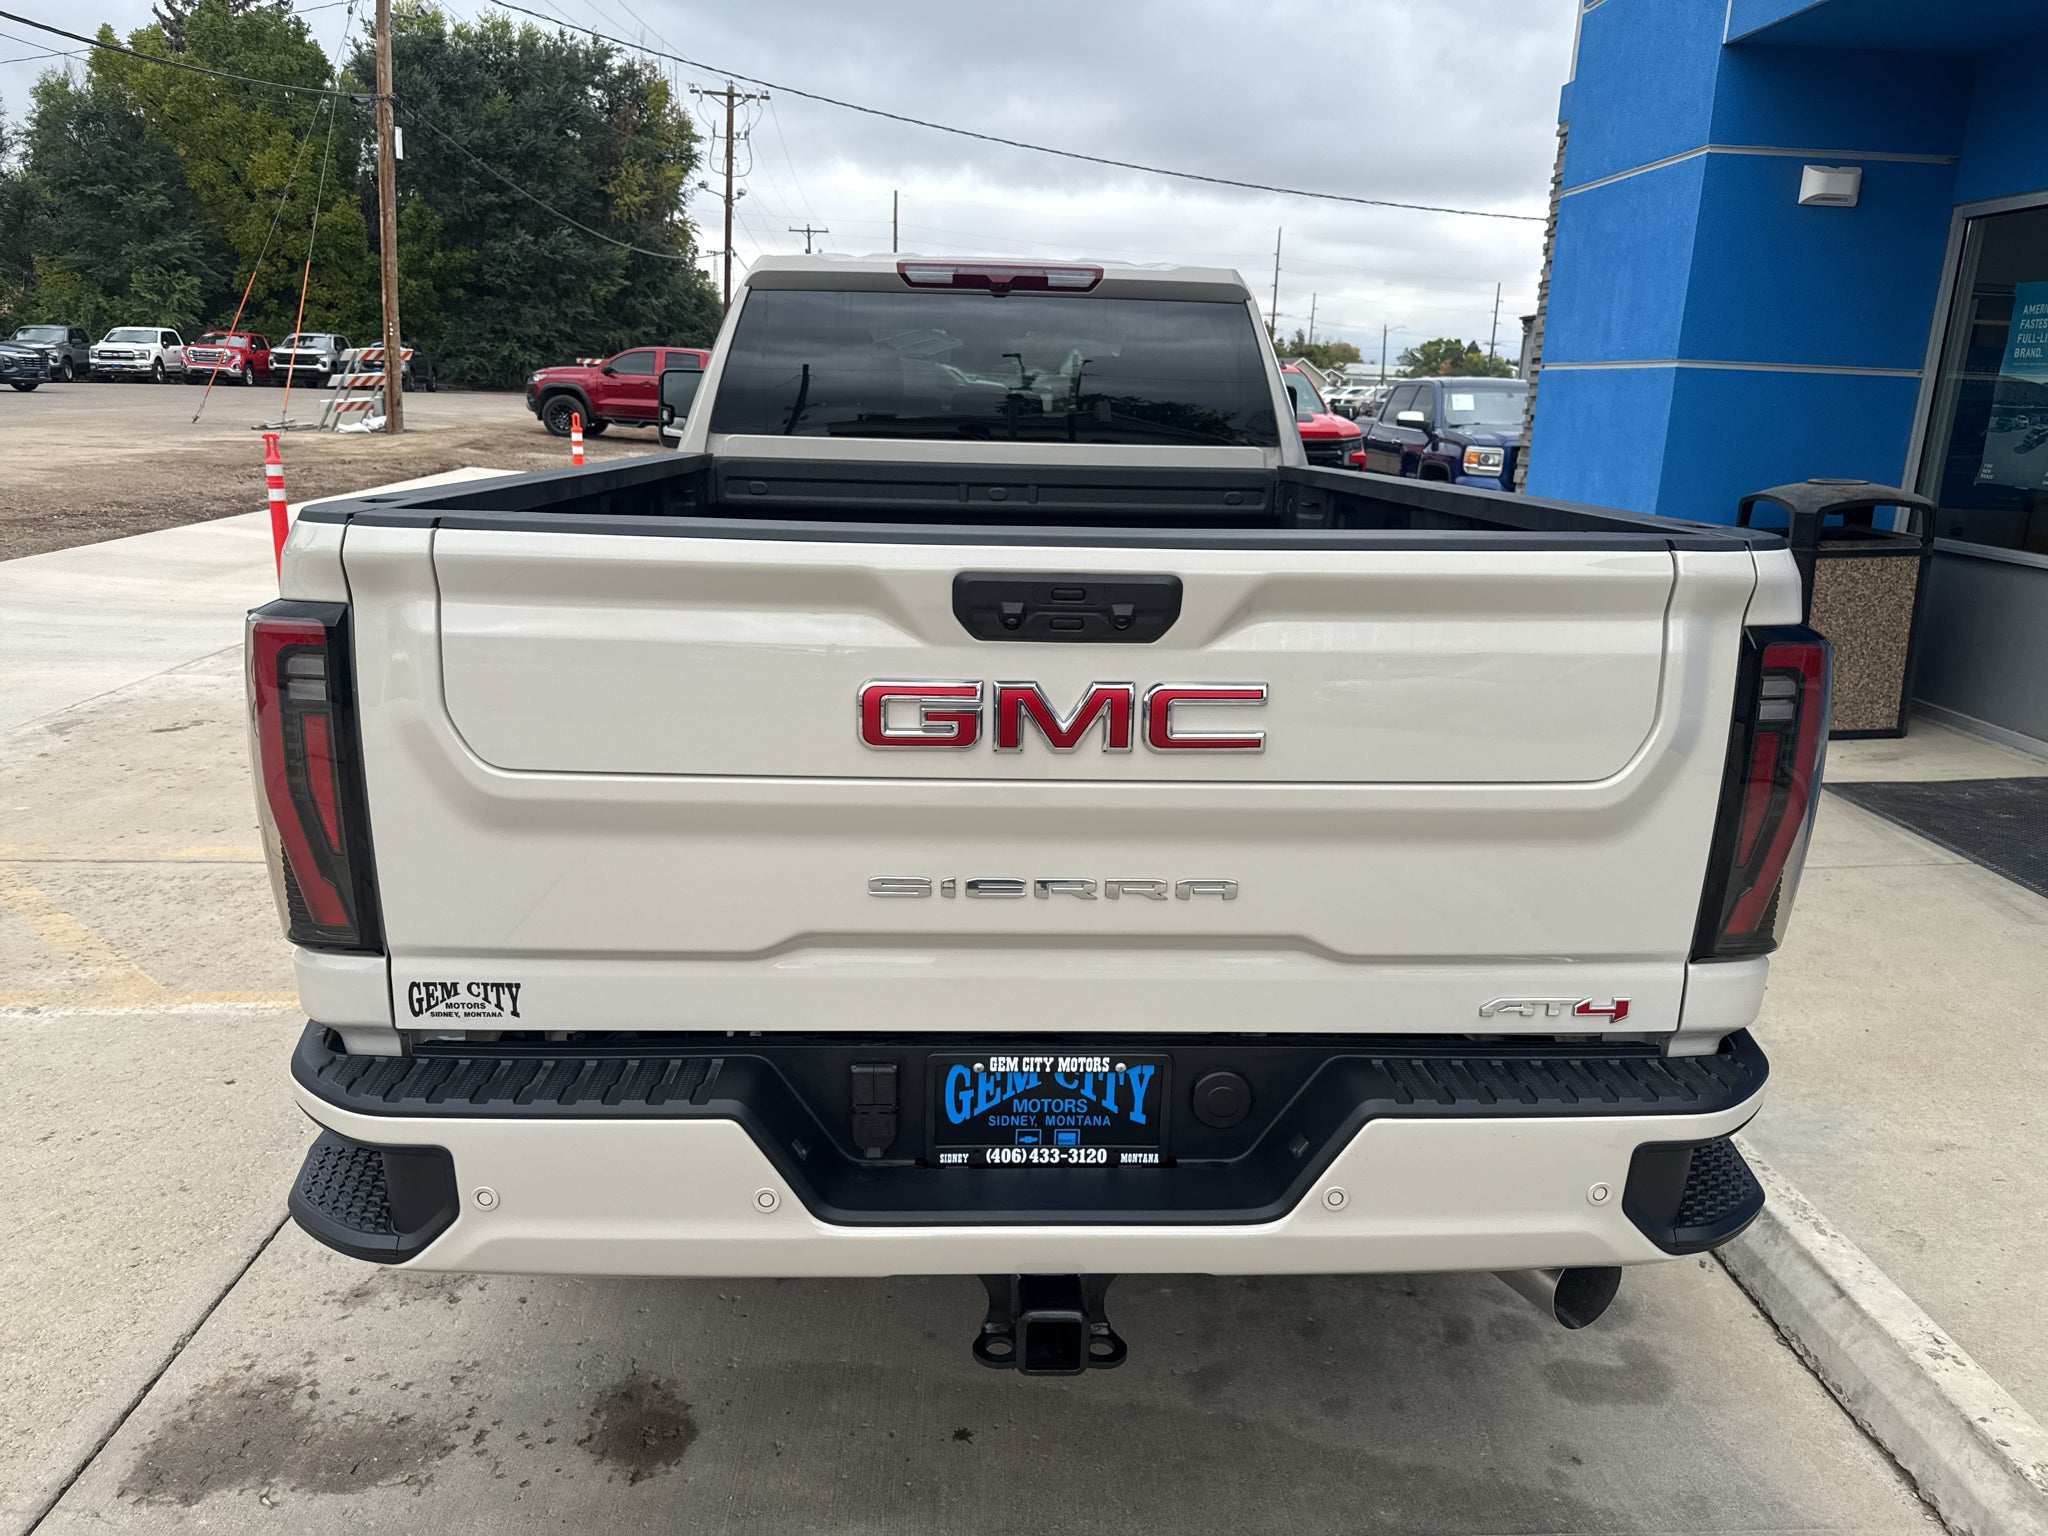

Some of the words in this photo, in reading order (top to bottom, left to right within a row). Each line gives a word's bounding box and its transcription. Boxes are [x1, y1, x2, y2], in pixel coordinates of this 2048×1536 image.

[2013, 347, 2043, 358] BRAND.
[857, 678, 1269, 755] GMC
[867, 875, 1239, 901] SIERRA
[408, 981, 460, 1018] GEM
[466, 982, 521, 1018] CITY
[445, 1002, 487, 1010] MOTORS
[1479, 997, 1632, 1023] AT4
[989, 1056, 1020, 1072] GEM
[1022, 1056, 1055, 1073] CITY
[1057, 1057, 1111, 1073] MOTORS
[944, 1063, 1042, 1125] GEM
[1054, 1064, 1156, 1125] CITY
[1012, 1098, 1088, 1113] MOTORS
[988, 1115, 1038, 1128] SIDNEY,
[1045, 1115, 1111, 1126] MONTANA
[939, 1153, 970, 1164] SIDNEY
[1120, 1153, 1160, 1164] MONTANA
